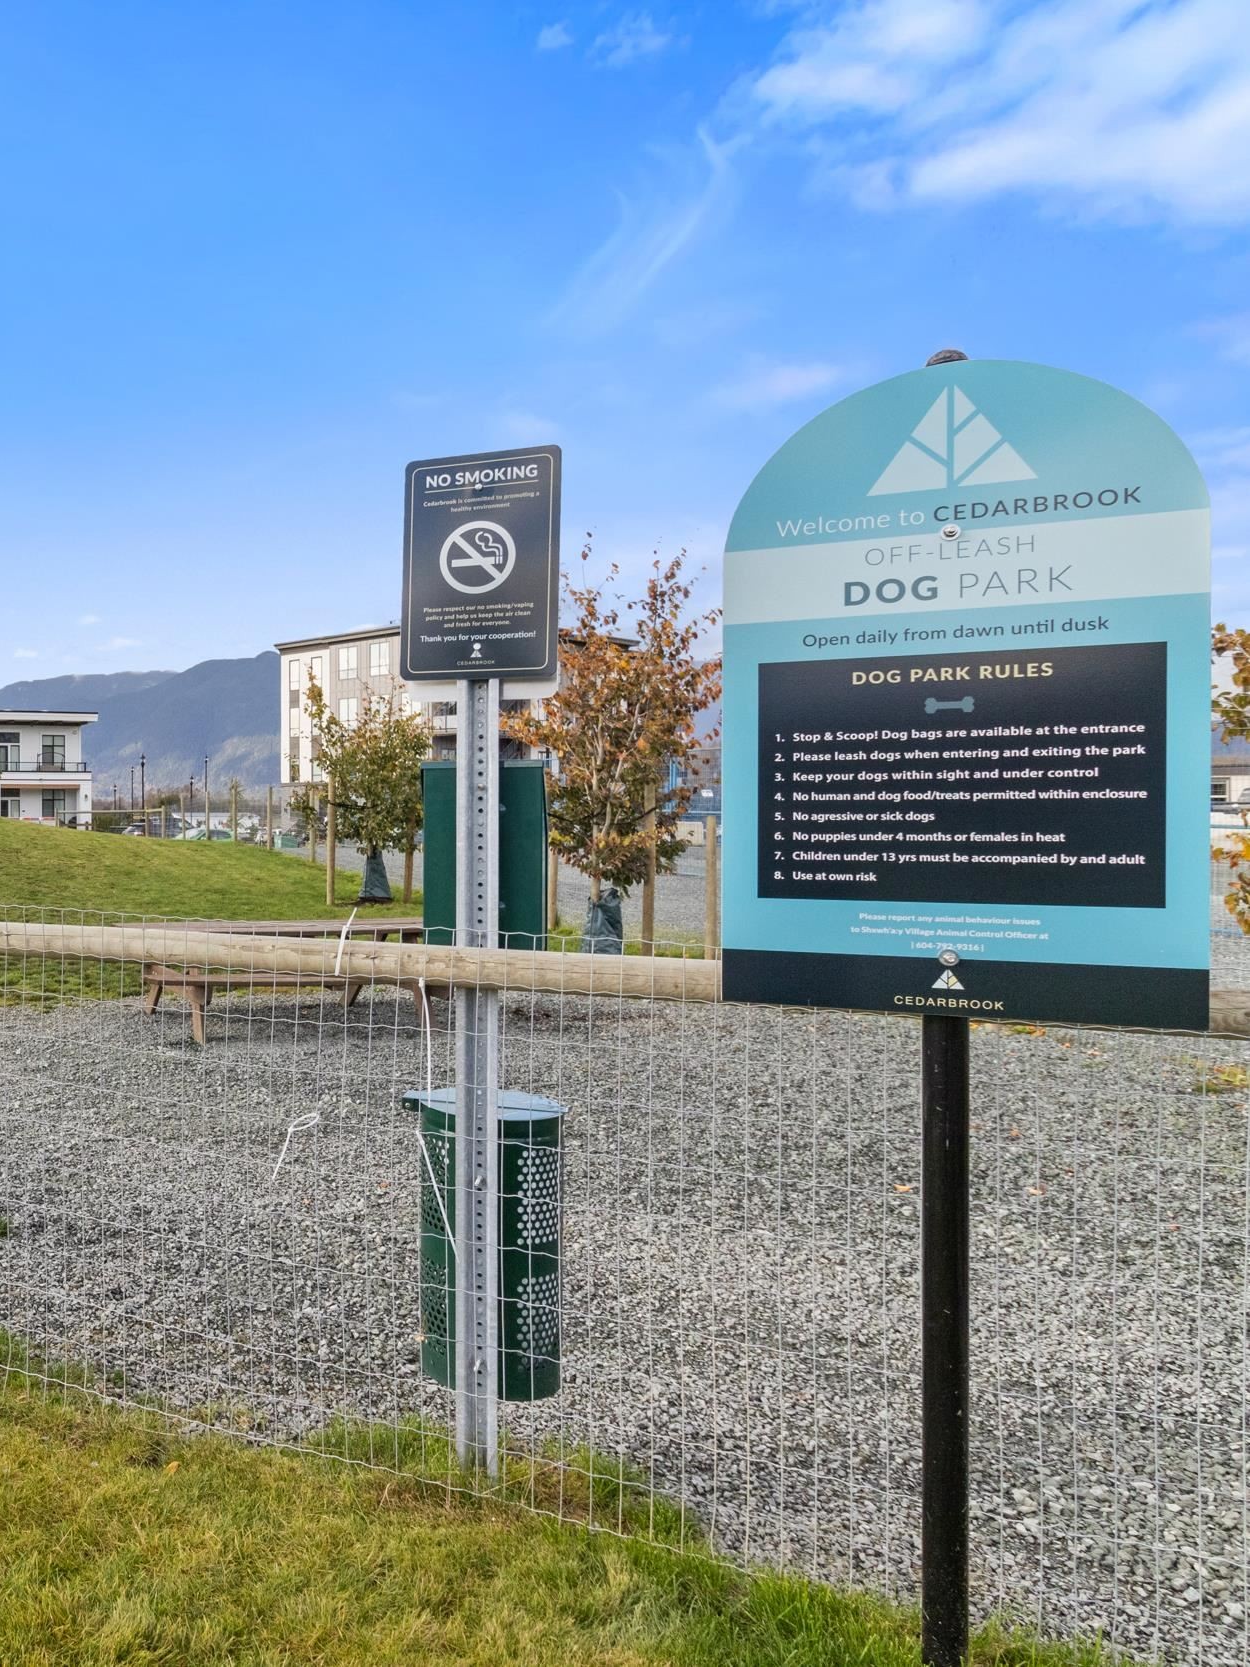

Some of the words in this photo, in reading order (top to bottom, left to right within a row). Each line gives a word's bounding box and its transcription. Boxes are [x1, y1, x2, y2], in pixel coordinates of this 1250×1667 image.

[426, 474, 451, 488] NO
[455, 465, 538, 485] SMOKING
[423, 498, 456, 507] Cedarbrook
[504, 491, 534, 500] promoting
[473, 502, 510, 510] environment
[776, 515, 890, 537] Welcome
[899, 510, 924, 526] to
[934, 486, 1141, 522] CEDARBROOK
[864, 535, 1035, 566] OFF-LEASH
[844, 576, 939, 607] DOG
[959, 564, 1073, 598] PARK
[443, 635, 457, 643] you
[489, 631, 536, 640] cooperation!
[802, 632, 850, 648] Open
[856, 629, 898, 645] daily
[904, 628, 947, 641] from
[953, 625, 1004, 638] dawn
[1011, 619, 1054, 635] until
[1061, 616, 1110, 632] dusk
[852, 670, 901, 685] DOG
[910, 666, 970, 682] PARK
[979, 662, 1053, 679] RULES
[775, 734, 785, 742] 1.
[793, 732, 821, 743] Stop
[824, 732, 834, 740] &
[836, 731, 878, 742] Scoop!
[882, 730, 907, 741] Dog
[911, 729, 942, 739] bags
[971, 727, 1032, 736] available
[1036, 727, 1050, 735] at
[1054, 725, 1077, 734] the
[1081, 724, 1145, 733] entrance
[775, 753, 785, 761] 2.
[793, 752, 831, 761] Please
[834, 751, 866, 760] leash
[870, 751, 901, 761] dogs
[904, 750, 939, 759] when
[943, 748, 999, 759] entering
[1003, 747, 1029, 756] and
[1032, 746, 1081, 757] exiting
[1085, 746, 1109, 755] the
[1113, 745, 1146, 756] park
[774, 773, 785, 782] 3.
[793, 772, 823, 783] Keep
[826, 773, 854, 782] your
[857, 771, 888, 782] dogs
[892, 770, 932, 779] within
[936, 770, 970, 781] sight
[973, 769, 999, 778] and
[1003, 769, 1044, 778] under
[1047, 767, 1098, 777] control
[774, 793, 785, 801] 4.
[853, 792, 875, 800] and
[878, 792, 901, 802] dog
[903, 791, 970, 800] food/treats
[973, 790, 1036, 801] permitted
[1038, 790, 1079, 799] within
[1082, 789, 1148, 798] enclosure
[774, 812, 785, 820] 5.
[793, 812, 809, 820] No
[811, 813, 864, 822] agressive
[881, 812, 903, 820] sick
[905, 812, 935, 822] dogs
[774, 832, 784, 840] 6.
[793, 832, 809, 840] No
[811, 832, 856, 842] puppies
[859, 833, 894, 841] under
[906, 833, 952, 841] months
[969, 832, 1018, 842] females
[1021, 833, 1033, 841] in
[1036, 833, 1065, 842] heat
[774, 852, 784, 860] 7.
[793, 852, 841, 860] Children
[844, 852, 879, 861] under
[882, 853, 896, 861] 13
[898, 854, 916, 863] yrs
[919, 853, 950, 862] must
[953, 853, 969, 862] be
[971, 854, 1057, 864] accompanied
[1061, 854, 1077, 865] by
[1080, 855, 1106, 864] and
[1109, 855, 1146, 864] adult
[793, 872, 813, 880] Use
[856, 873, 877, 881] risk
[859, 913, 886, 921] Please
[966, 917, 1011, 925] behaviour
[1013, 918, 1041, 926] issues
[905, 928, 934, 936] Village
[937, 929, 967, 937] Animal
[969, 930, 1003, 938] Control
[1005, 931, 1037, 939] Officer
[894, 995, 1004, 1010] CEDARBROOK
